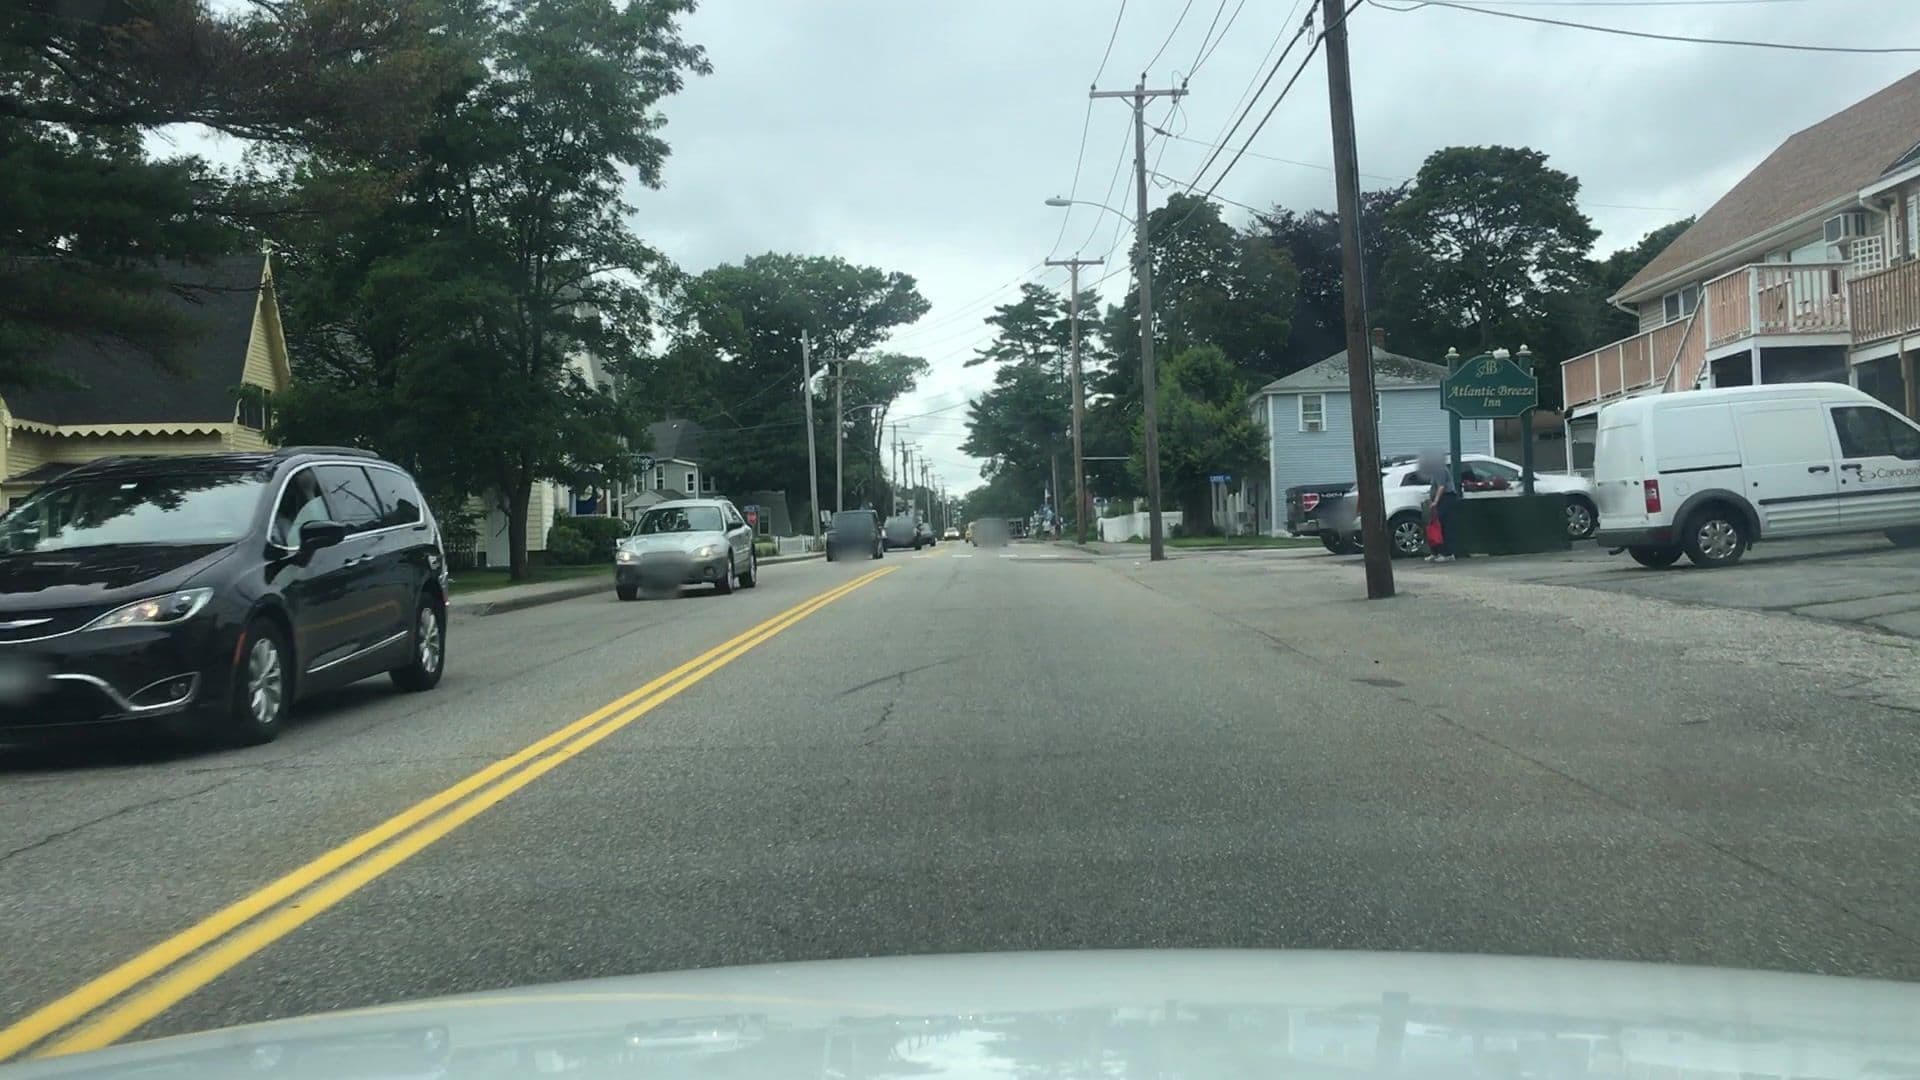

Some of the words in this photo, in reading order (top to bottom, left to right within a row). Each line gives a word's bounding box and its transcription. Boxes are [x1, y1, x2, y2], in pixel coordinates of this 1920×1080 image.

[1447, 384, 1496, 399] Atlantic
[1497, 385, 1535, 397] Breeze
[1483, 397, 1502, 408] Inn
